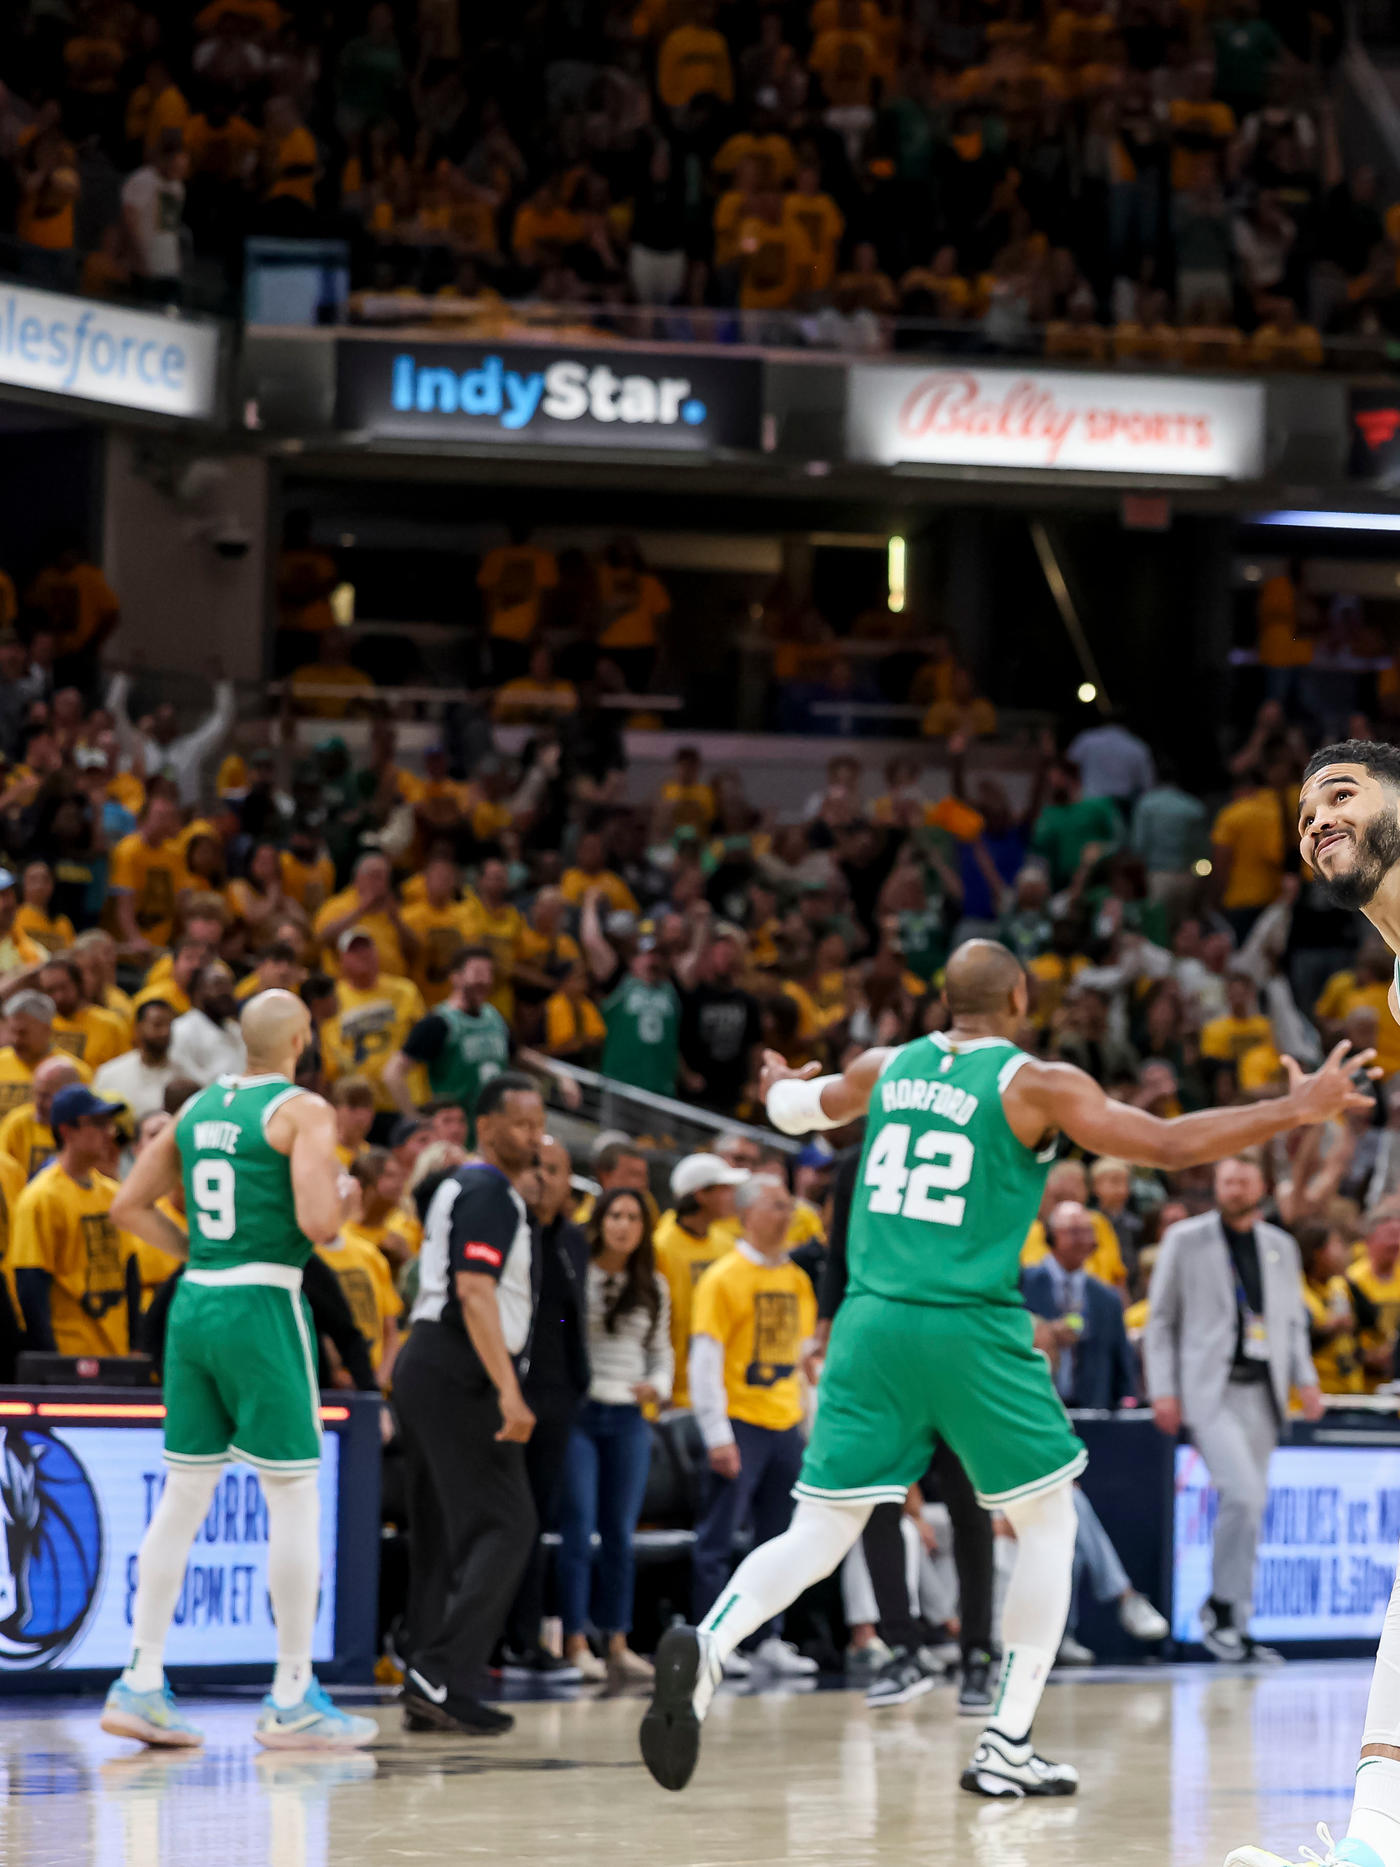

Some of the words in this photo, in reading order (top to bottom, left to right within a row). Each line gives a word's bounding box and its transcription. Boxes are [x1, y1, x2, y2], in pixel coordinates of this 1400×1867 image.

[0, 293, 186, 390] lesforce
[899, 369, 1077, 465] Bally
[1084, 405, 1212, 450] SPORTS
[193, 1119, 243, 1155] WHITE
[881, 1078, 979, 1127] HORFORD
[192, 1157, 236, 1241] 9
[863, 1122, 976, 1227] 42
